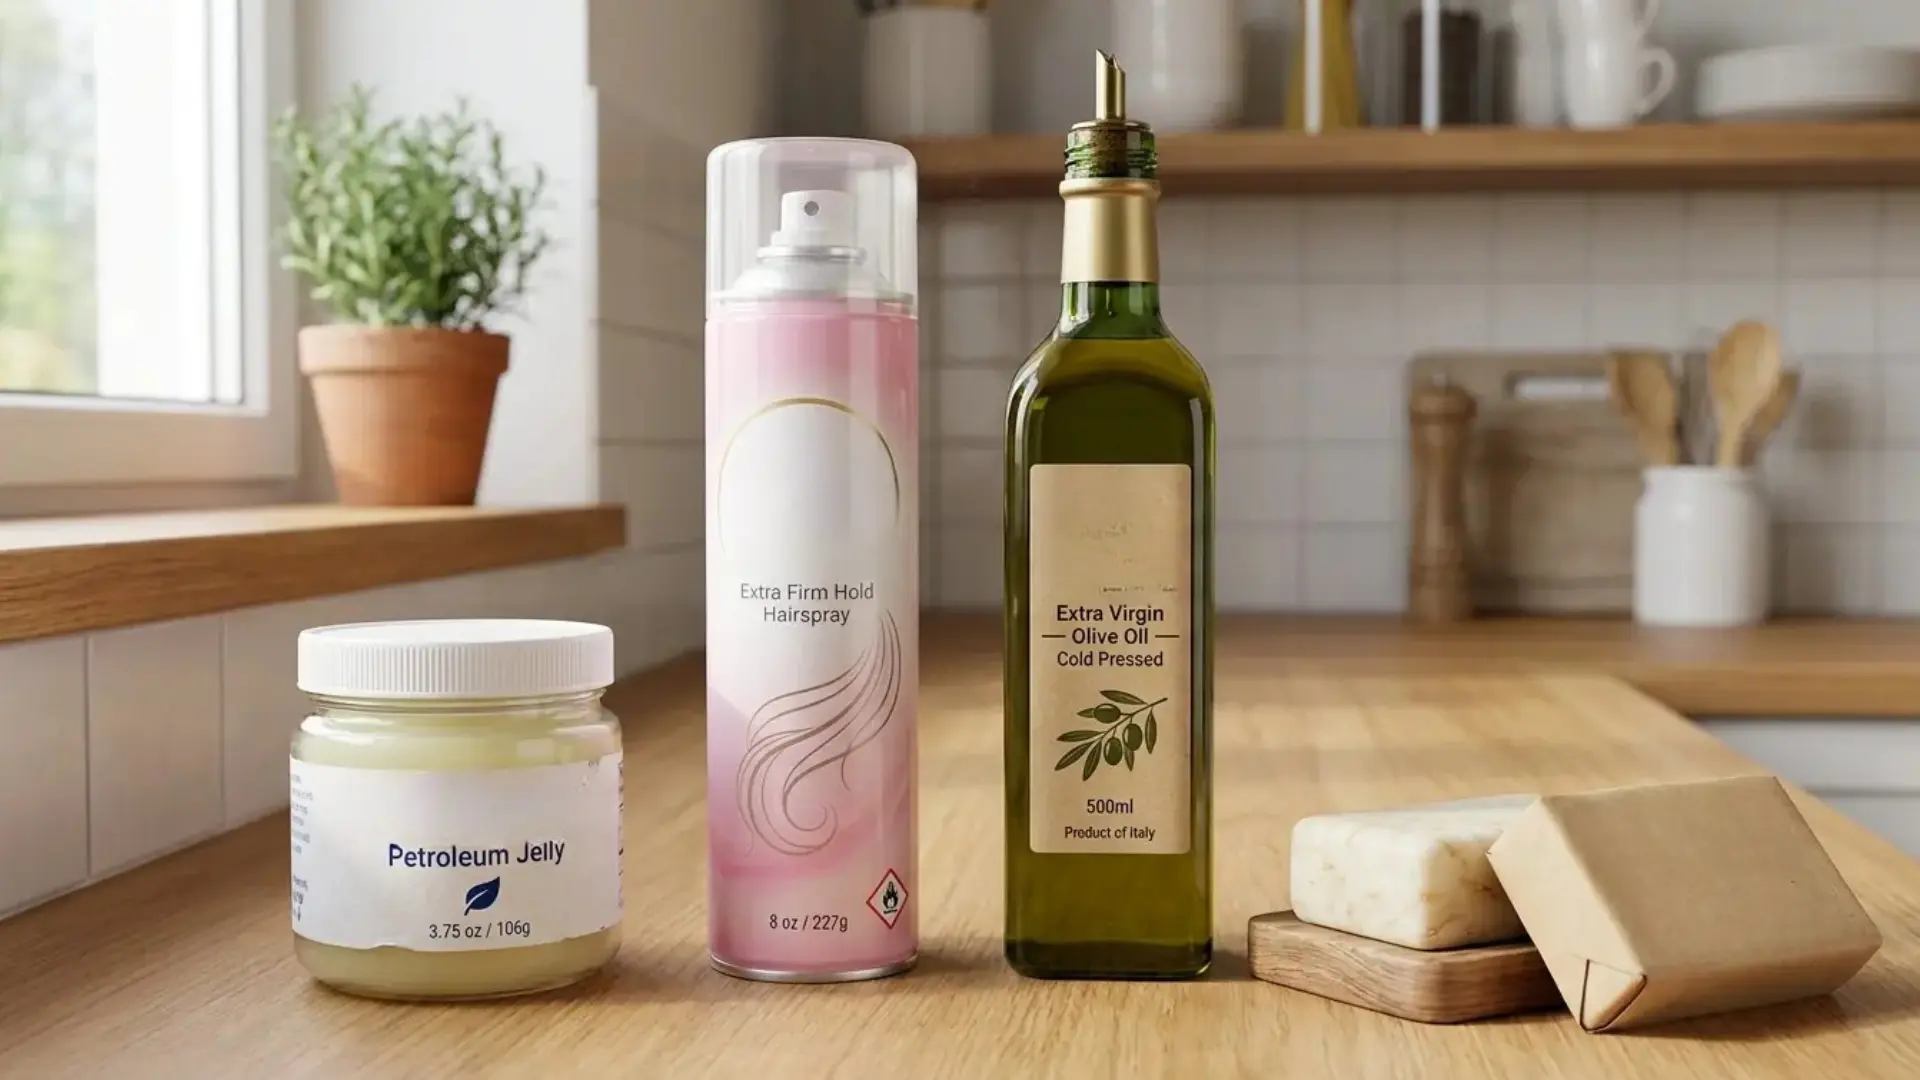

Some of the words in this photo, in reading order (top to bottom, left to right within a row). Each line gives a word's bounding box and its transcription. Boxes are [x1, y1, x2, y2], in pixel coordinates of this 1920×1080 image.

[740, 583, 781, 600] Extra
[787, 584, 828, 600] Firm
[834, 582, 874, 600] Hold
[763, 606, 850, 626] Hairspray
[1057, 604, 1103, 621] Extra
[1109, 604, 1164, 625] Virgin
[1071, 628, 1119, 644] Olive
[1057, 651, 1093, 666] Cold
[1098, 651, 1164, 666] Pressed
[1086, 798, 1133, 814] 500ml
[1064, 826, 1112, 838] Product
[1130, 826, 1155, 841] Italy
[389, 843, 509, 867] Petroleum
[517, 840, 565, 864] Jelly
[429, 923, 461, 939] 3.75
[465, 926, 481, 938] oz
[497, 920, 531, 937] 106g
[769, 913, 778, 929] 8
[782, 917, 798, 930] oz
[812, 915, 848, 933] 227g
